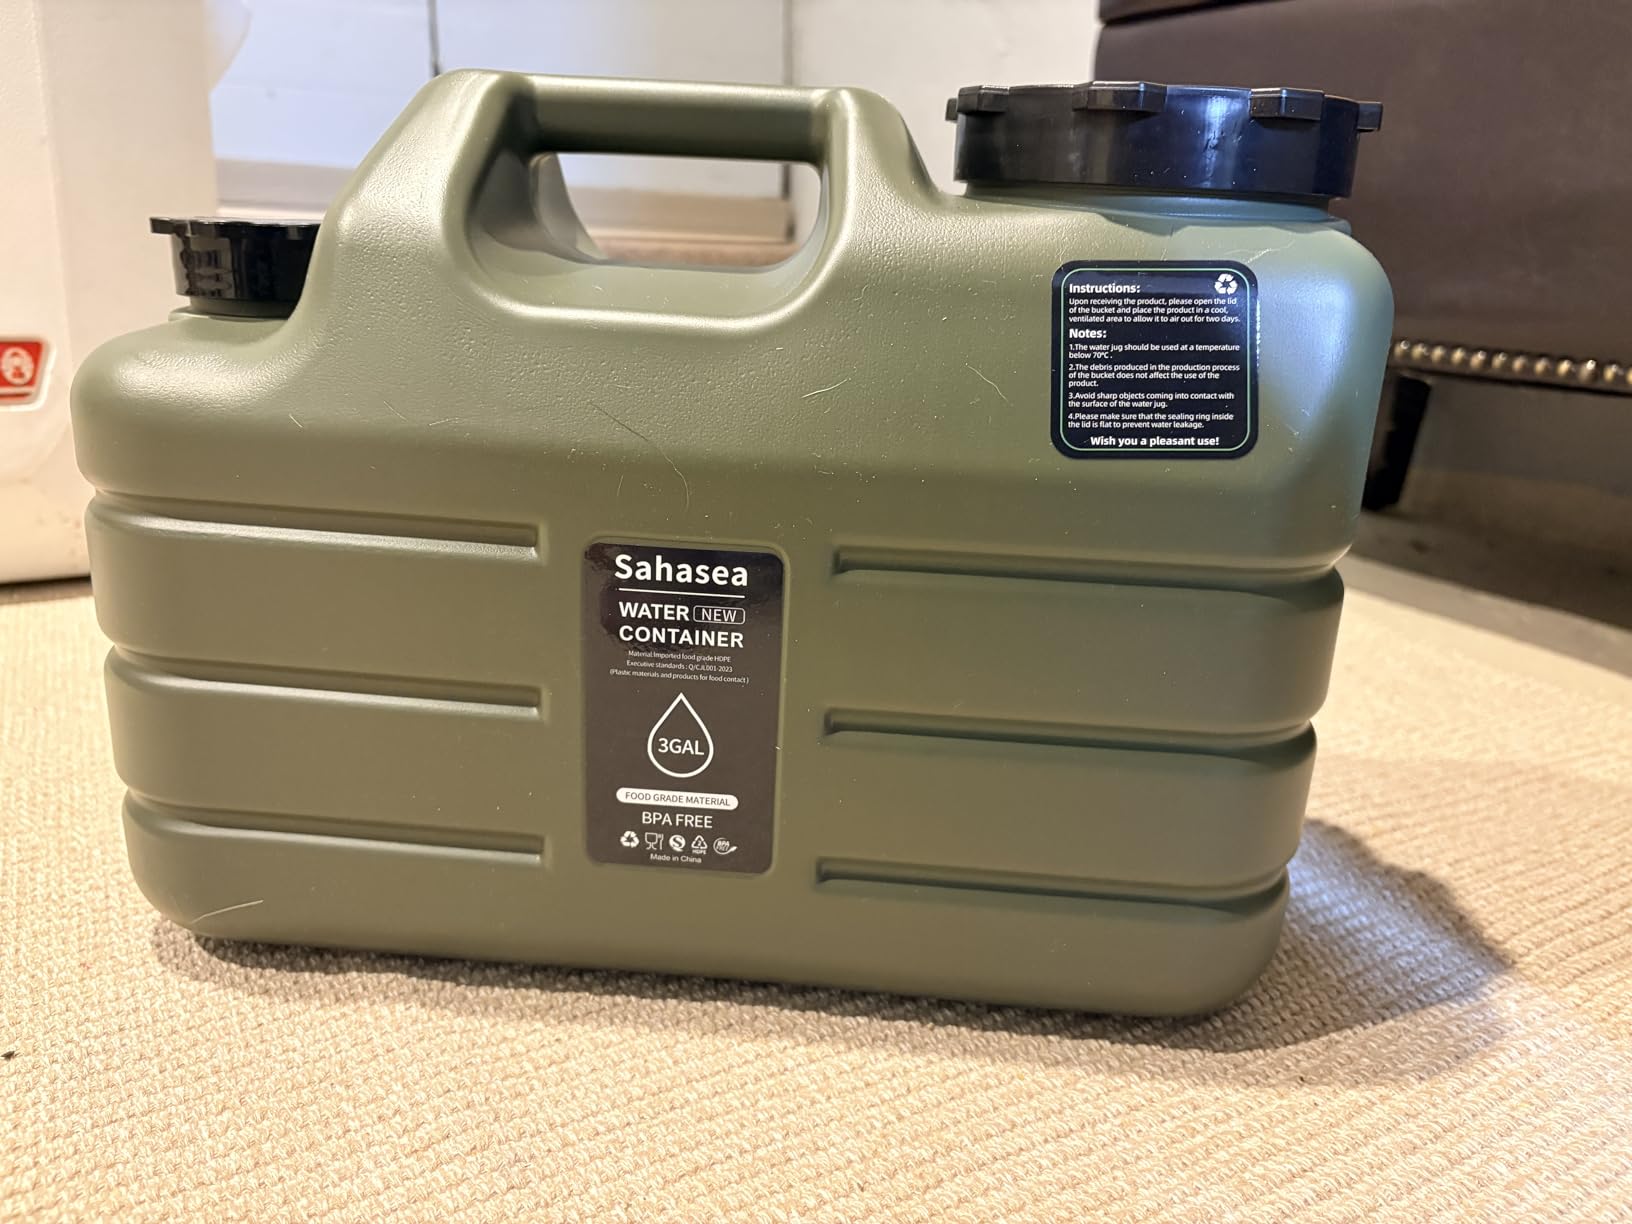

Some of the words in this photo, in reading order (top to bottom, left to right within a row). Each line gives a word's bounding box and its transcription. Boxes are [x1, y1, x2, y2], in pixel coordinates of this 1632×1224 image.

[1069, 284, 1141, 293] Instructions:
[1069, 329, 1106, 338] Notes:
[1090, 436, 1116, 445] Wish
[1118, 438, 1138, 447] you
[1149, 437, 1195, 447] pleasant
[1197, 437, 1219, 446] use!
[614, 554, 748, 586] Sahasea
[619, 602, 689, 621] WATER
[702, 608, 736, 622] NEW
[619, 625, 743, 648] CONTAINER
[658, 738, 704, 755] 3GAL
[625, 792, 651, 800] FOOD
[653, 794, 683, 803] GRADE
[686, 797, 730, 806] MATERIAL
[642, 811, 672, 826] BPA
[676, 814, 713, 828] FREE
[681, 855, 702, 863] China
